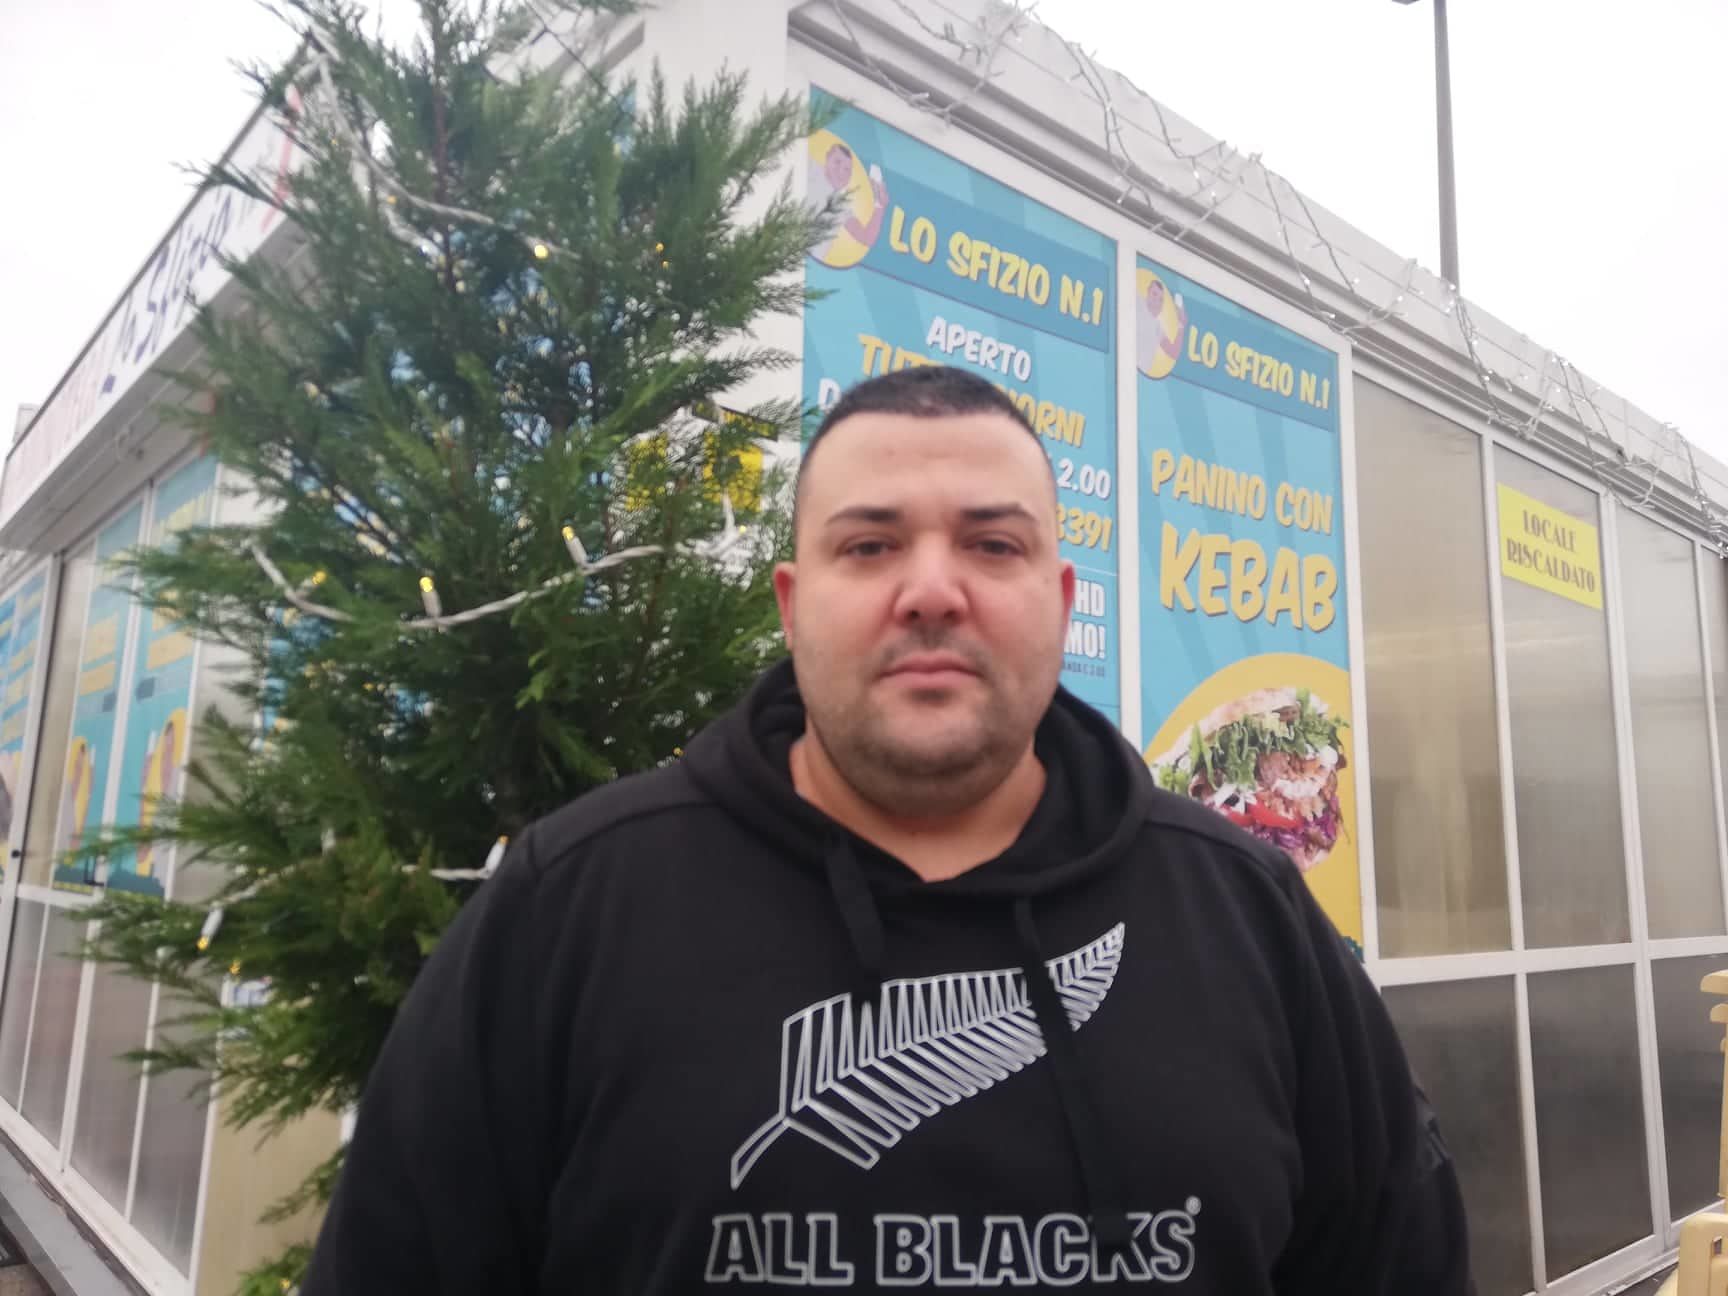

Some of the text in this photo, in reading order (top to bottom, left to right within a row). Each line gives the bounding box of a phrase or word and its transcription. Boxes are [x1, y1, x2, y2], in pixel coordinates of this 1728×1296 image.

[889, 205, 937, 264] LO
[946, 231, 1051, 306] SFIZIO
[926, 315, 1031, 382] APERTO
[1188, 324, 1219, 369] LO
[1225, 341, 1295, 397] SFIZIO
[993, 383, 1087, 449] ORNI
[1151, 447, 1333, 536] PANINO CON
[1506, 537, 1596, 593] RISCALDATO
[1523, 509, 1576, 552] LOCALE
[1159, 520, 1339, 634] KEBAB
[704, 1212, 855, 1286] ALL
